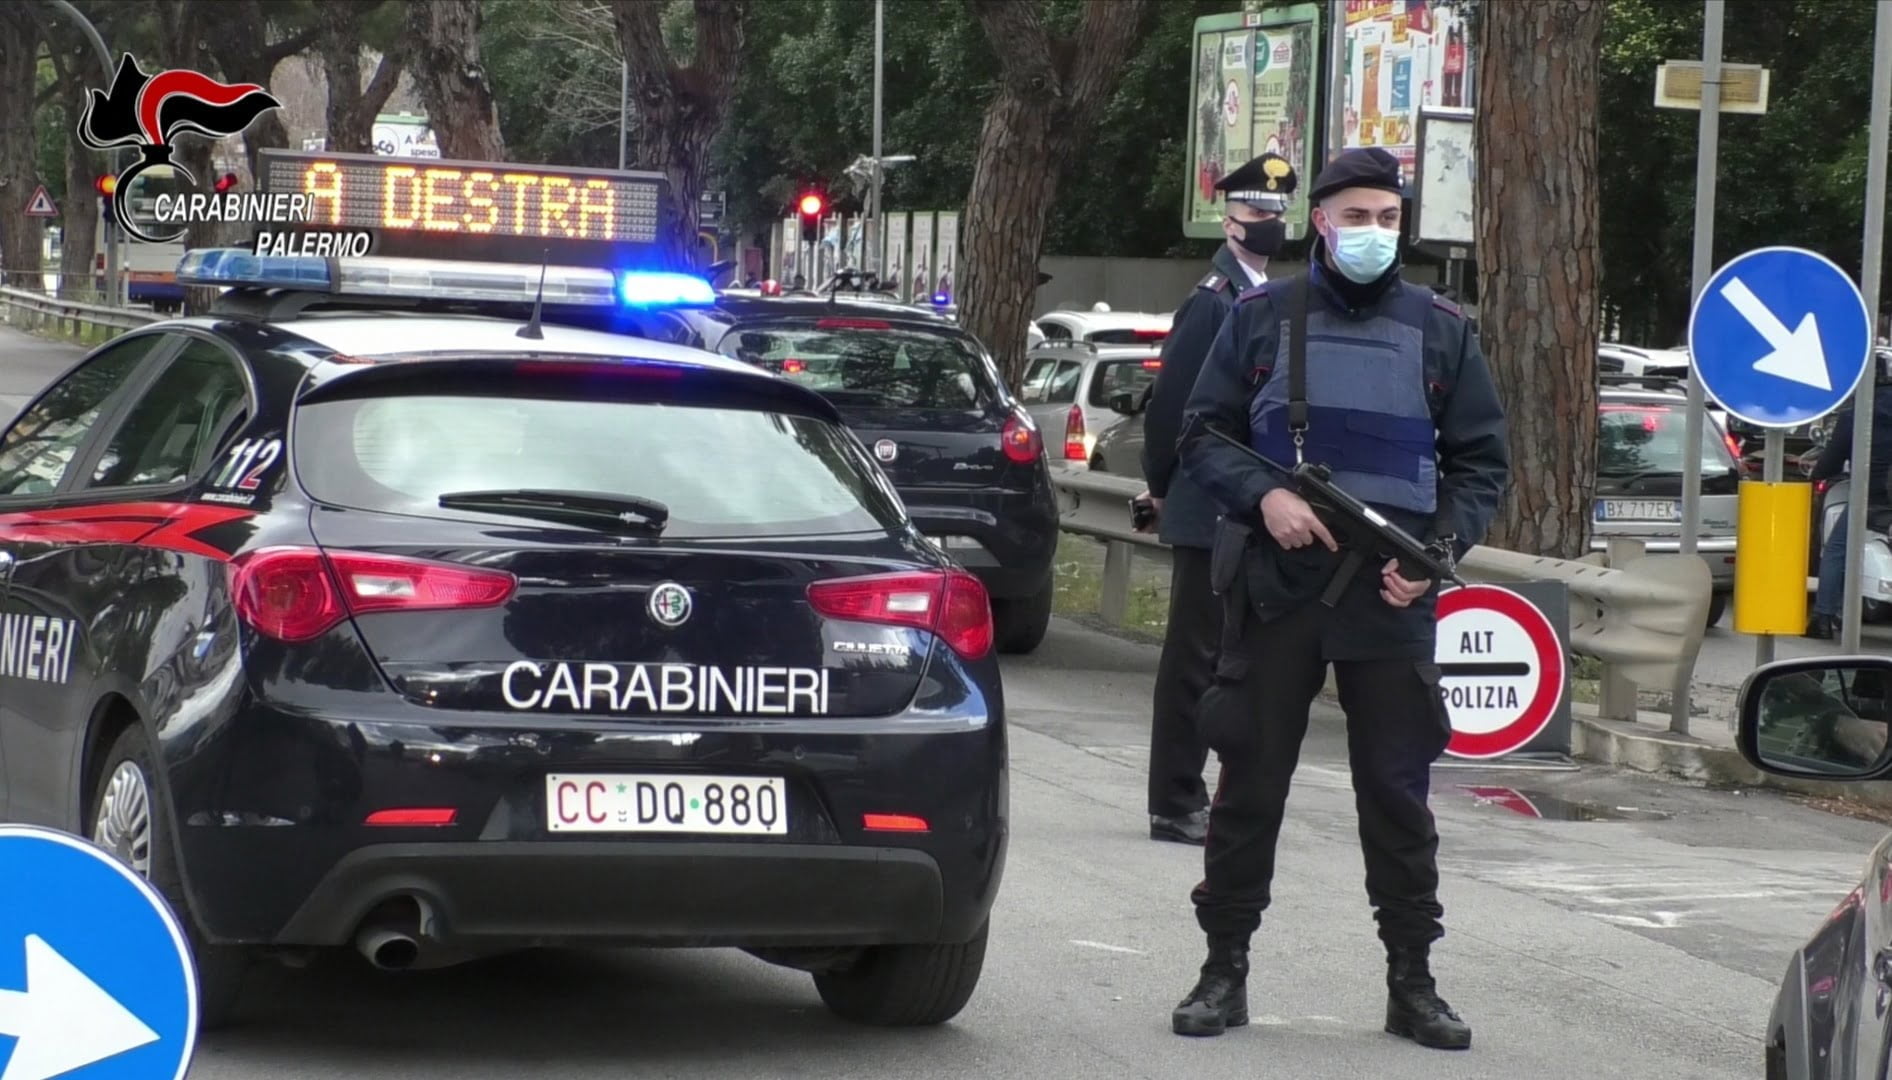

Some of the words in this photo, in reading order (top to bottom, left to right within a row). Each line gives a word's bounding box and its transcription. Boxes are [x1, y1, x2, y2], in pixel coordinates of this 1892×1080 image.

[304, 162, 342, 225] A
[384, 166, 615, 240] DESTRA
[213, 438, 282, 490] 112
[1607, 502, 1625, 517] BX
[1630, 502, 1673, 517] 717EK
[0, 613, 76, 684] NIERI
[1460, 631, 1494, 653] ALT
[502, 660, 829, 713] CARABINIERI
[1440, 686, 1518, 709] POLIZIA
[557, 780, 607, 824] CC
[636, 781, 684, 824] DQ
[704, 783, 777, 826] 880
